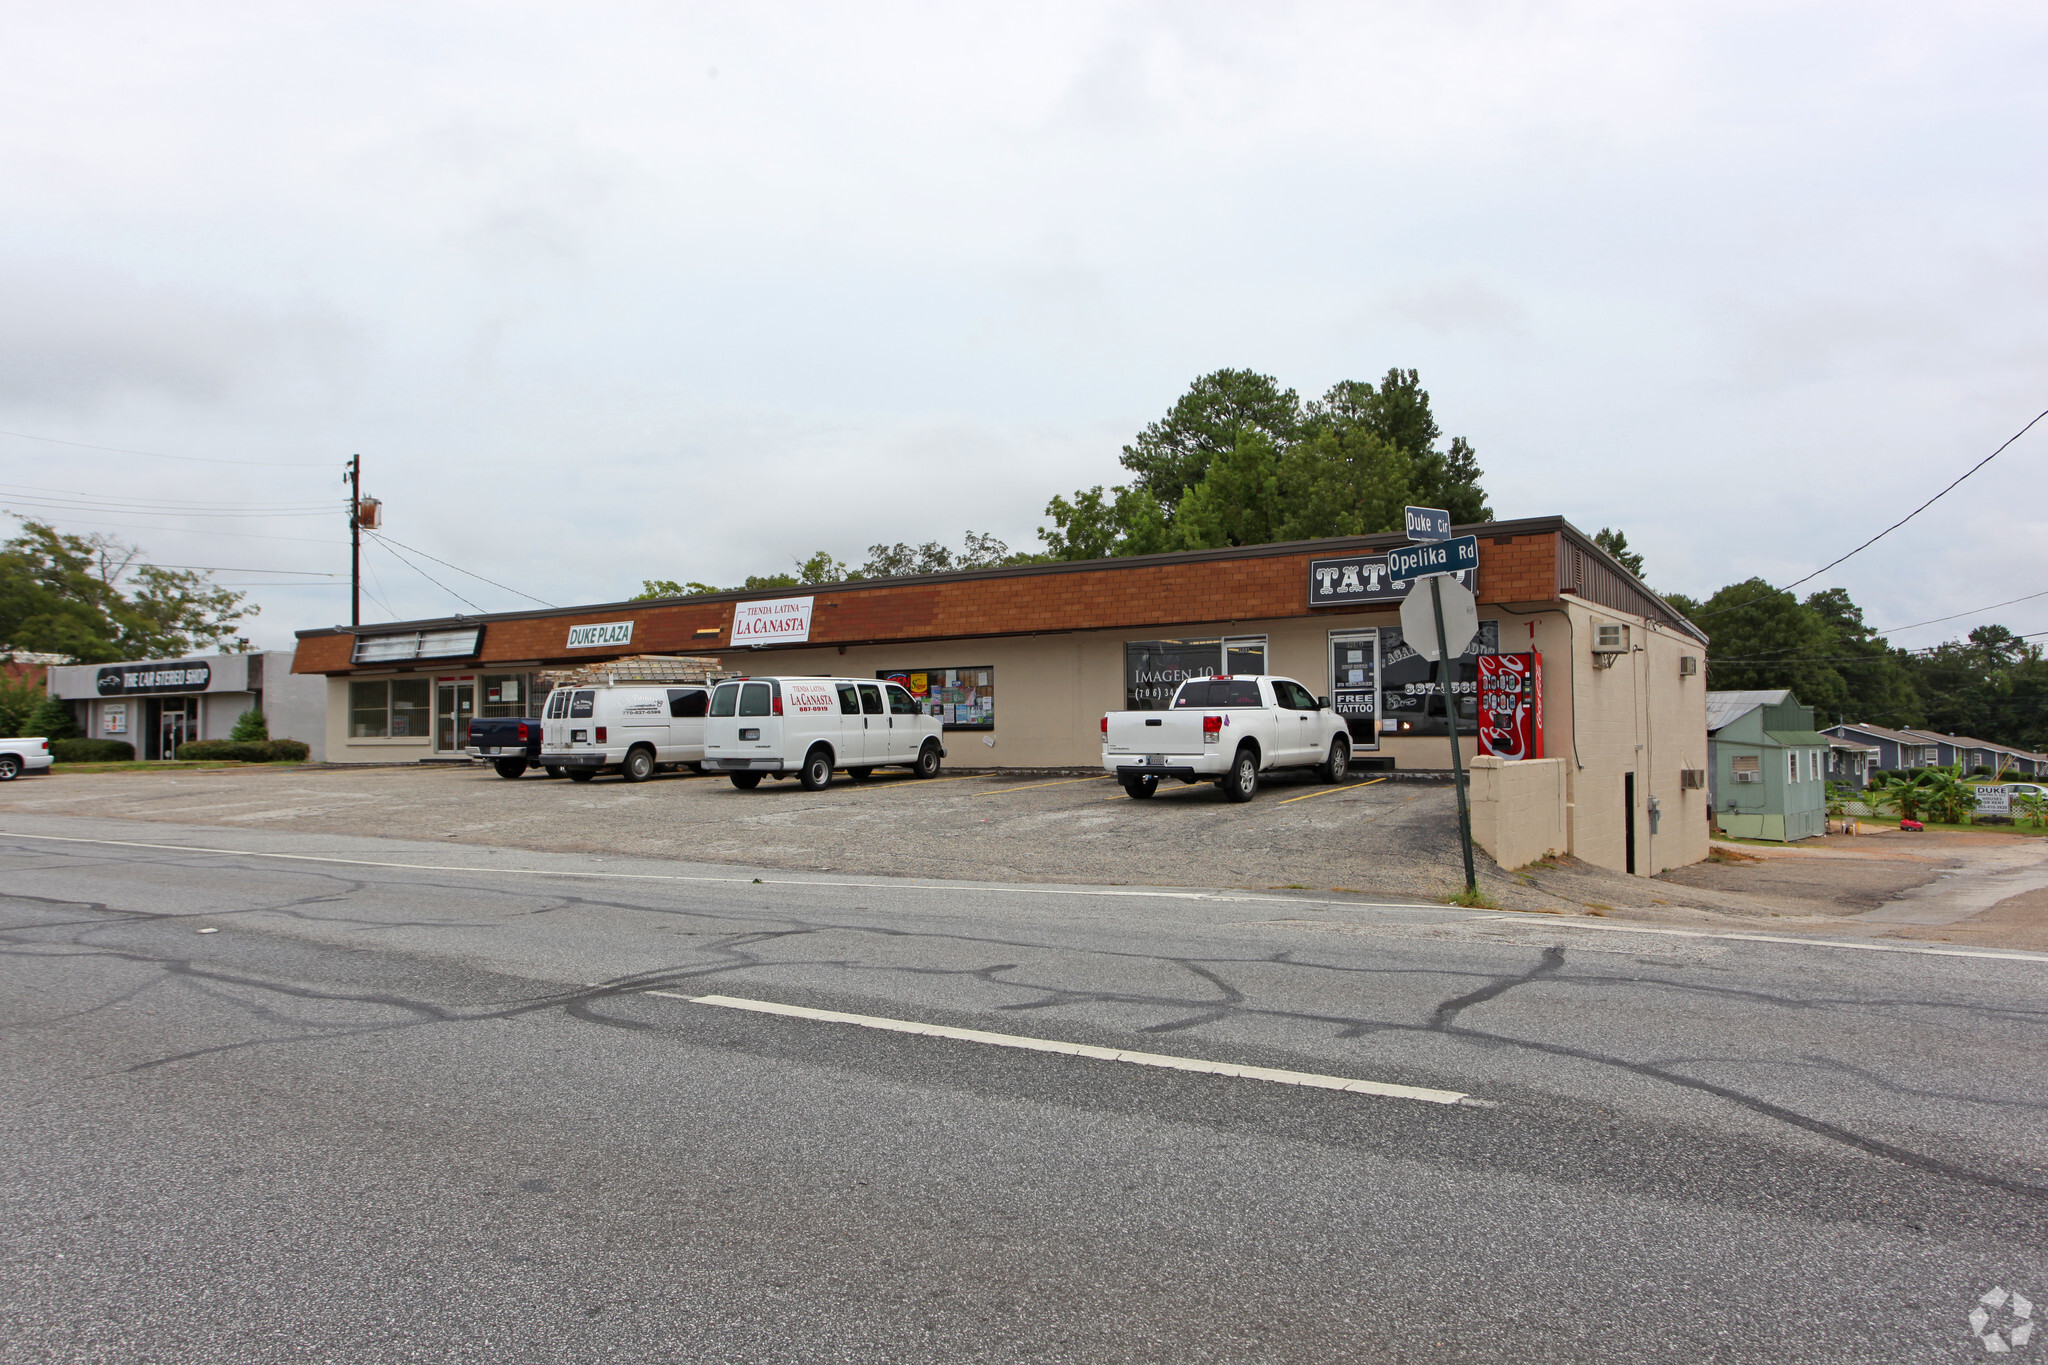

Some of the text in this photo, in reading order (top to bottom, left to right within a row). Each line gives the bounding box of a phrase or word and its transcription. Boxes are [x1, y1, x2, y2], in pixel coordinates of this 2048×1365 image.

[1408, 512, 1448, 533] Duke Cir
[1390, 544, 1474, 575] Opelika Rd
[747, 603, 799, 616] TIENDA LATINA
[570, 624, 629, 646] DUKE PLAZA
[736, 617, 804, 635] LA CANASTA
[124, 668, 208, 687] THE CAR STEREO SHOP
[1135, 669, 1192, 684] IMAGEN
[1337, 694, 1374, 703] FREE
[1337, 704, 1374, 713] TATTOO
